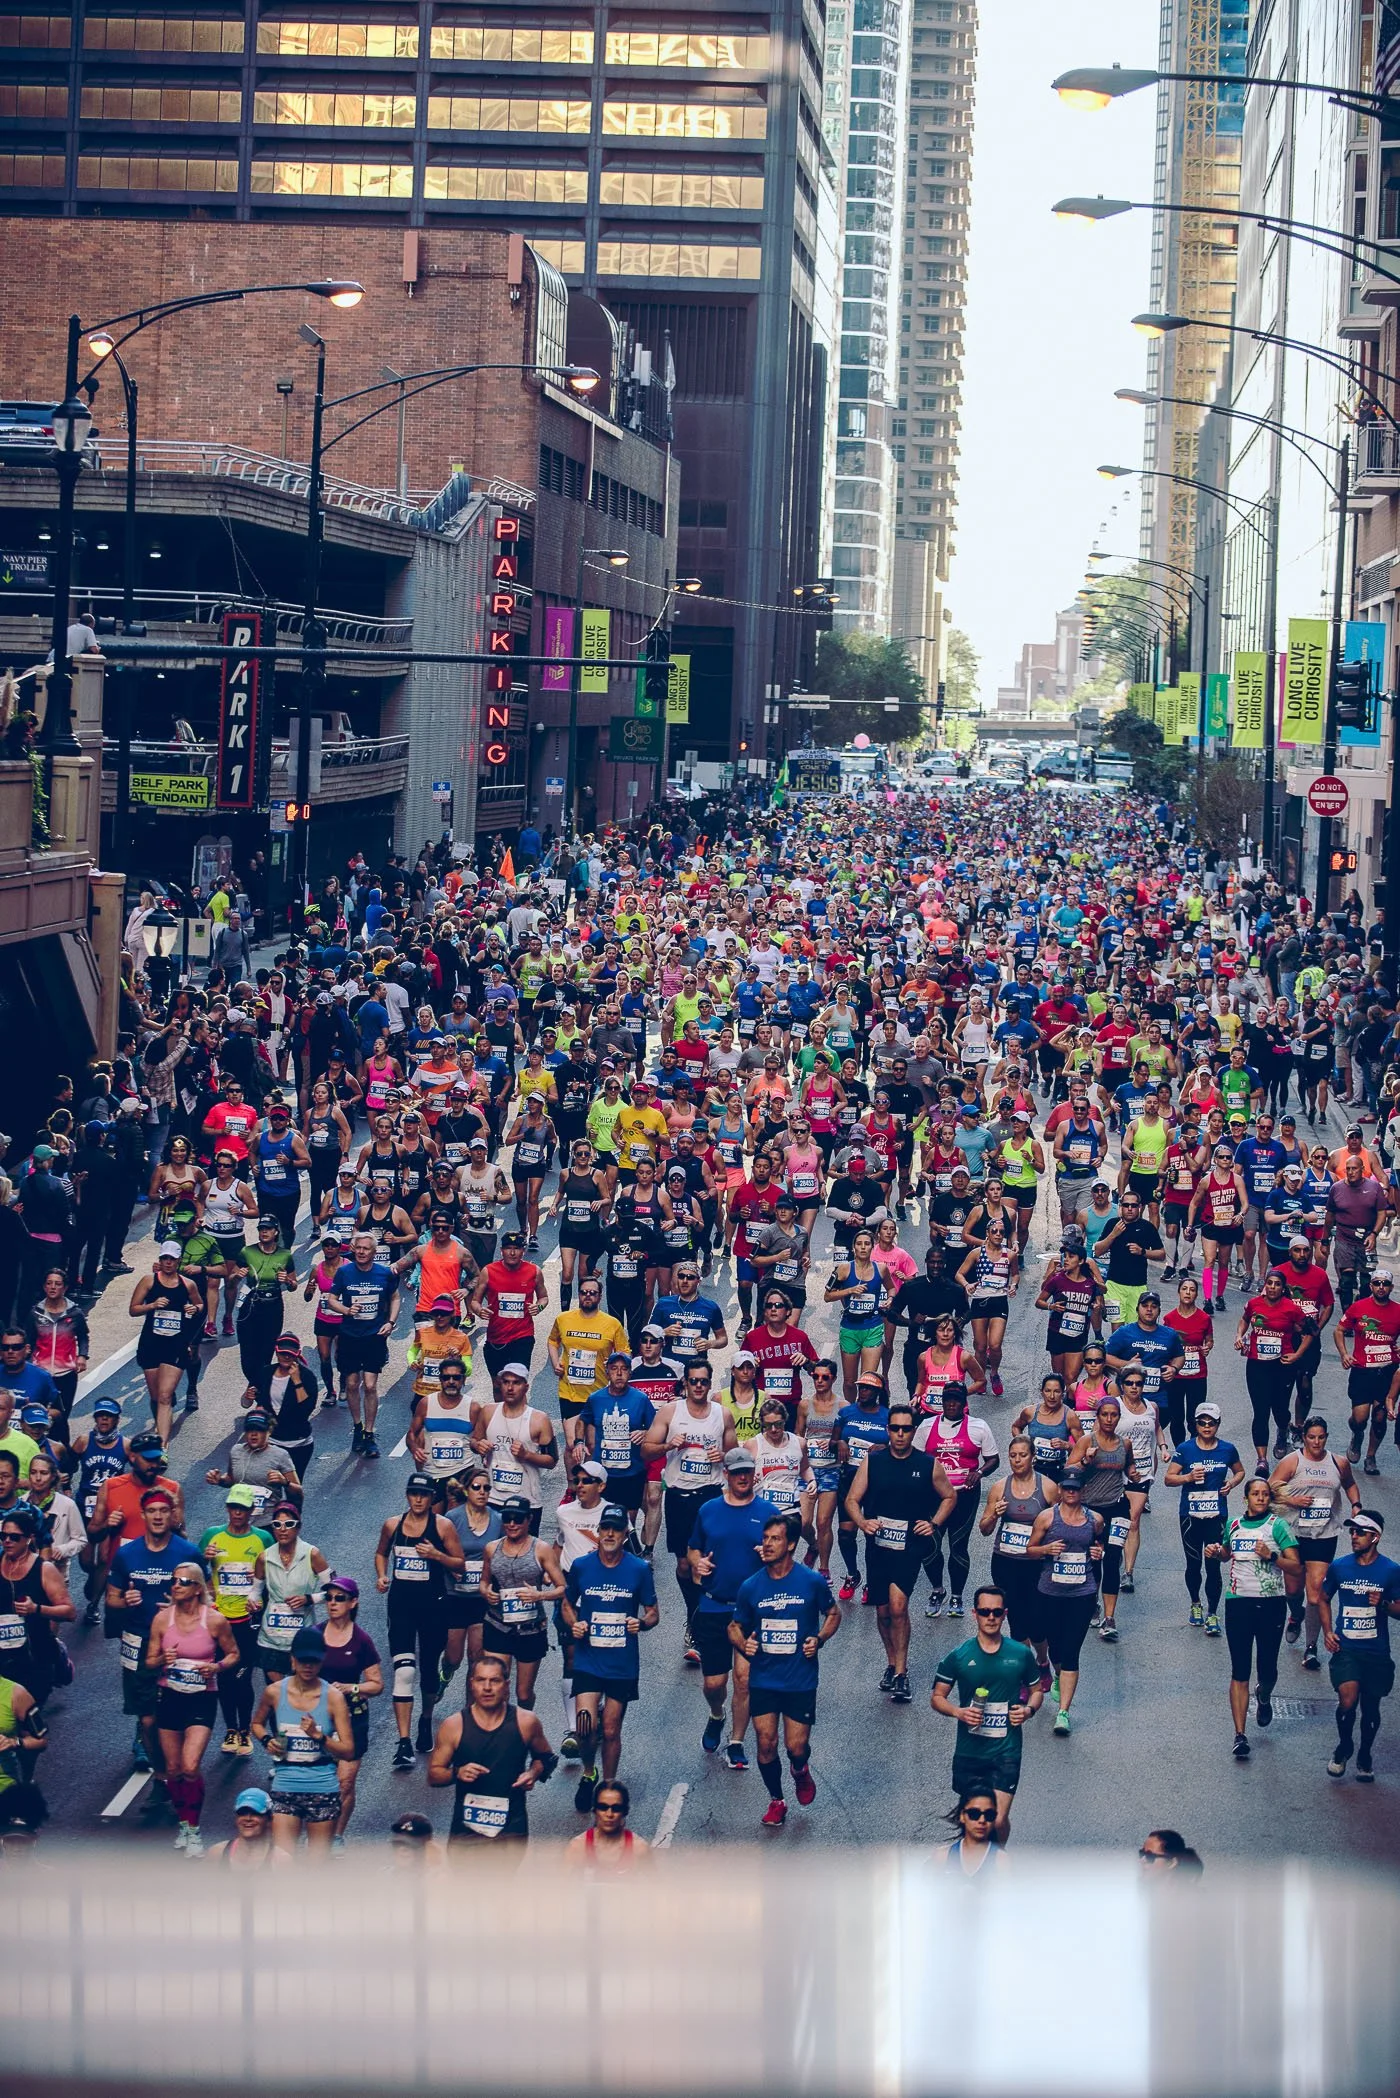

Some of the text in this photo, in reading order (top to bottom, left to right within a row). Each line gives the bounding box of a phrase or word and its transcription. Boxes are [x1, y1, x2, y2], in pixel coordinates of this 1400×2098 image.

[2, 555, 48, 564] NAVY PIER
[10, 564, 48, 572] TROLLEY
[487, 519, 516, 764] PARKING
[584, 625, 595, 677] LOG LIVE
[596, 626, 606, 677] CUIOSITY
[1287, 642, 1306, 719] LONG LIVE
[1304, 643, 1323, 720] CURIOSITY
[678, 668, 688, 711] CURIOSITY
[669, 688, 678, 710] LONG
[1179, 684, 1189, 724] LONG LIVE
[1188, 685, 1198, 724] CURIOSITY
[1236, 670, 1250, 730] LONG LIVE
[1250, 670, 1263, 730] CURIOSITY
[227, 627, 252, 794] PARK 1
[1166, 715, 1174, 734] LONG
[132, 777, 204, 791] SELF PARK
[790, 774, 838, 792] JESUS
[1314, 783, 1341, 791] DO NOT
[130, 791, 206, 804] ATTENDANT
[1315, 801, 1341, 809] ENTER
[1211, 1194, 1235, 1206] HEART
[850, 1301, 854, 1309] G
[153, 1319, 181, 1329] G 38363
[1263, 1345, 1281, 1353] 32179
[568, 1367, 595, 1377] G 31919
[773, 1378, 792, 1387] 34061
[1145, 1377, 1160, 1385] 1413
[925, 1395, 930, 1403] G
[432, 1449, 462, 1457] G 35110
[601, 1450, 630, 1460] G 38783
[86, 1455, 105, 1467] HAPPY
[681, 1463, 711, 1473] G 31090
[1305, 1468, 1327, 1477] Kate
[492, 1471, 522, 1484] G 33286
[764, 1492, 793, 1502] G 31091
[1189, 1502, 1218, 1511] G 32923
[1301, 1509, 1330, 1519] G 36799
[883, 1529, 906, 1541] 34702
[1111, 1525, 1117, 1534] F
[1001, 1532, 1006, 1542] G
[1231, 1540, 1257, 1551] G 3384
[397, 1558, 427, 1570] F 24581
[1054, 1563, 1085, 1574] G 35000
[1340, 1583, 1384, 1592] Chicago Marathon
[607, 1590, 633, 1598] Marathon
[503, 1601, 509, 1612] G
[779, 1597, 805, 1606] Marathon
[269, 1615, 304, 1627] G 30662
[1344, 1619, 1376, 1629] F 30259
[590, 1625, 625, 1636] G 39848
[762, 1632, 797, 1643] G 32553
[464, 1806, 506, 1825] G 36468
